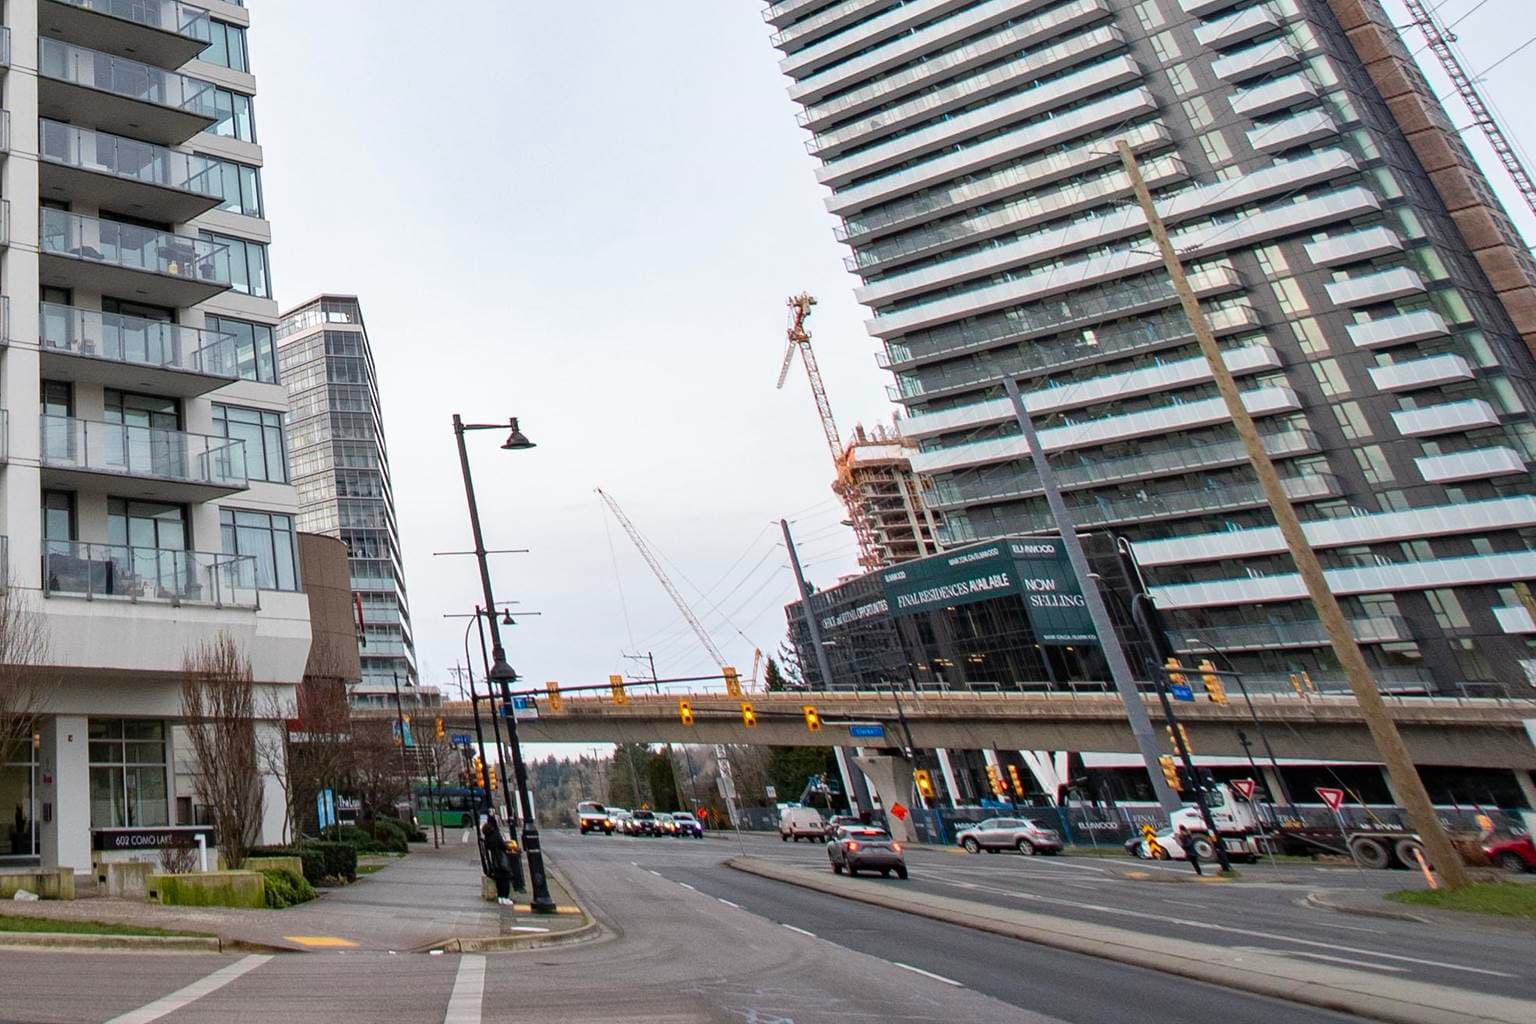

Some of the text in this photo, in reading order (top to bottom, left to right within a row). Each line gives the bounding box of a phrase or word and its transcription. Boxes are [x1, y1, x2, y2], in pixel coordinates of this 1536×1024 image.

[1011, 544, 1056, 554] ELMWOOD
[897, 573, 1010, 608] FINAL RESIDENCES AVAILABLE
[1024, 578, 1056, 591] NOW
[1030, 594, 1085, 607] SELLING
[115, 835, 130, 846] 602
[130, 835, 156, 845] COMO
